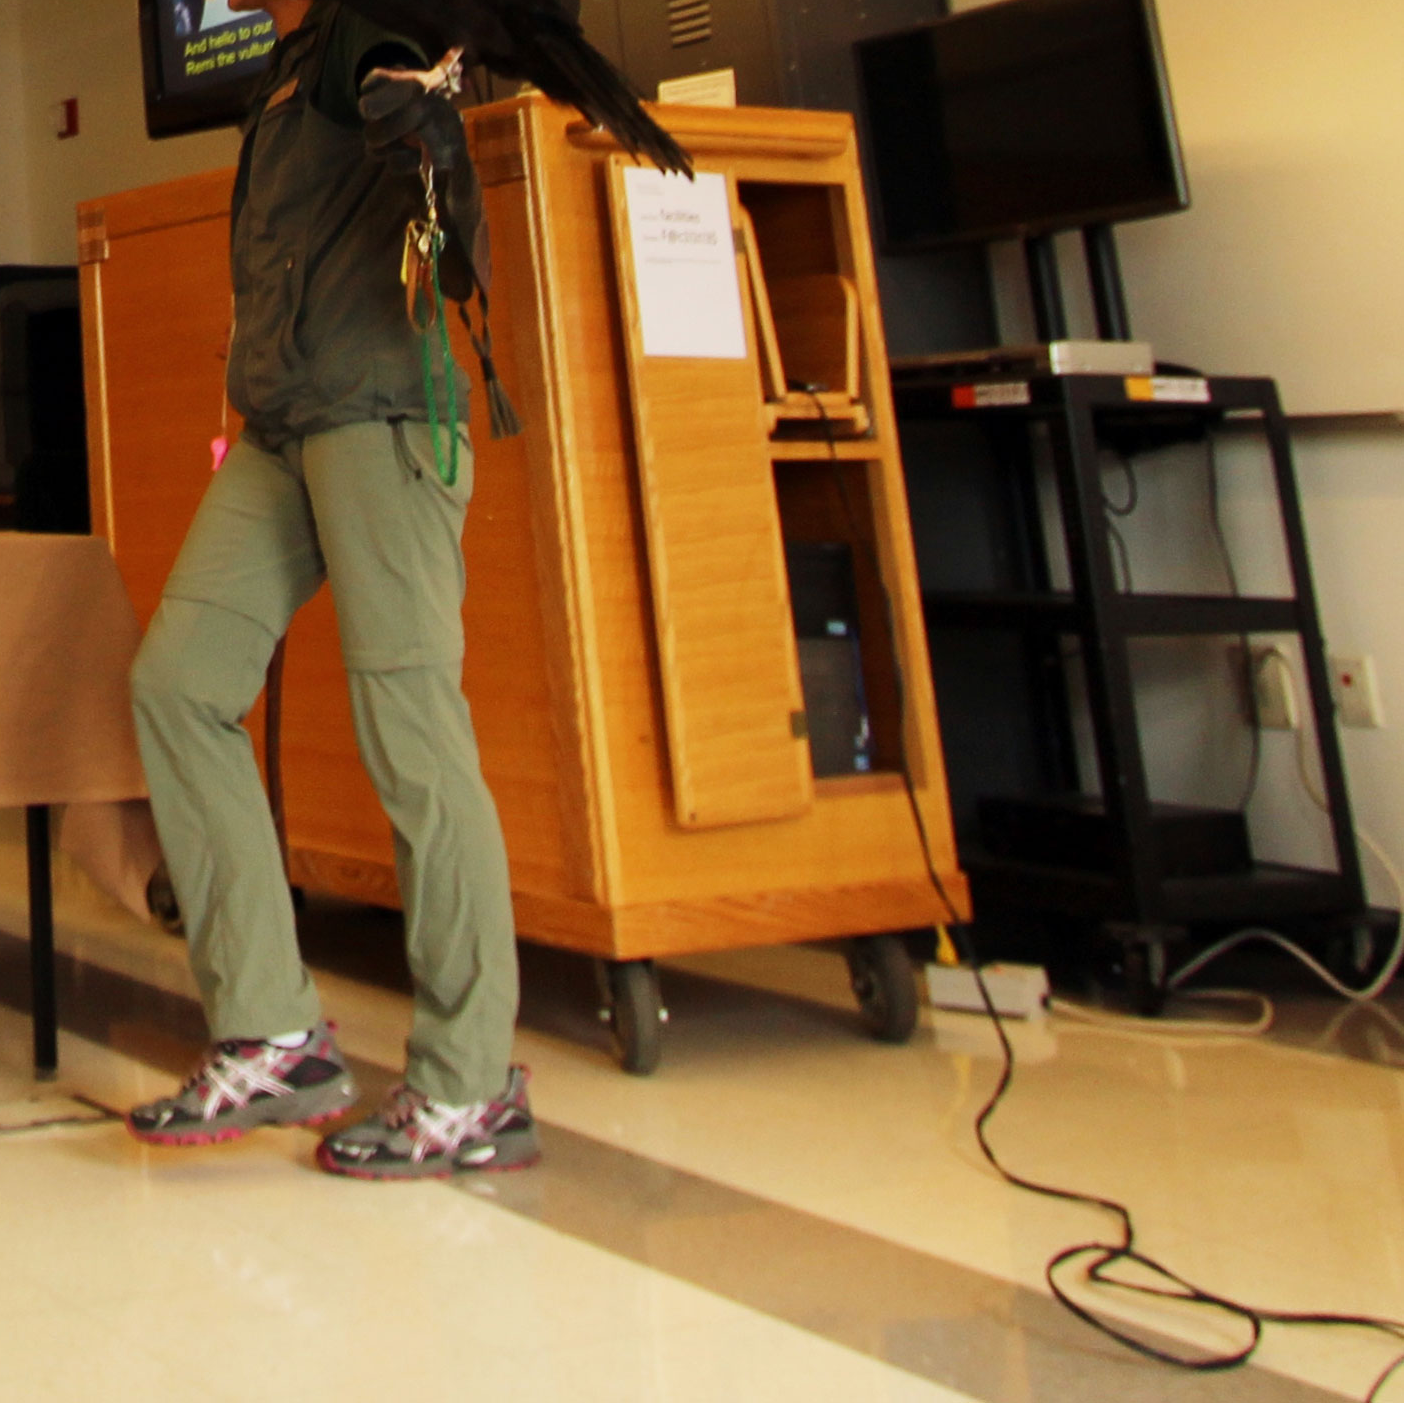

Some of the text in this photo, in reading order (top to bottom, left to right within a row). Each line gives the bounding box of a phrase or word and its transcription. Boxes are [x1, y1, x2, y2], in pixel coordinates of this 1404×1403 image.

[184, 38, 207, 57] And
[209, 30, 237, 49] hello
[239, 27, 251, 40] to
[217, 52, 236, 66] the
